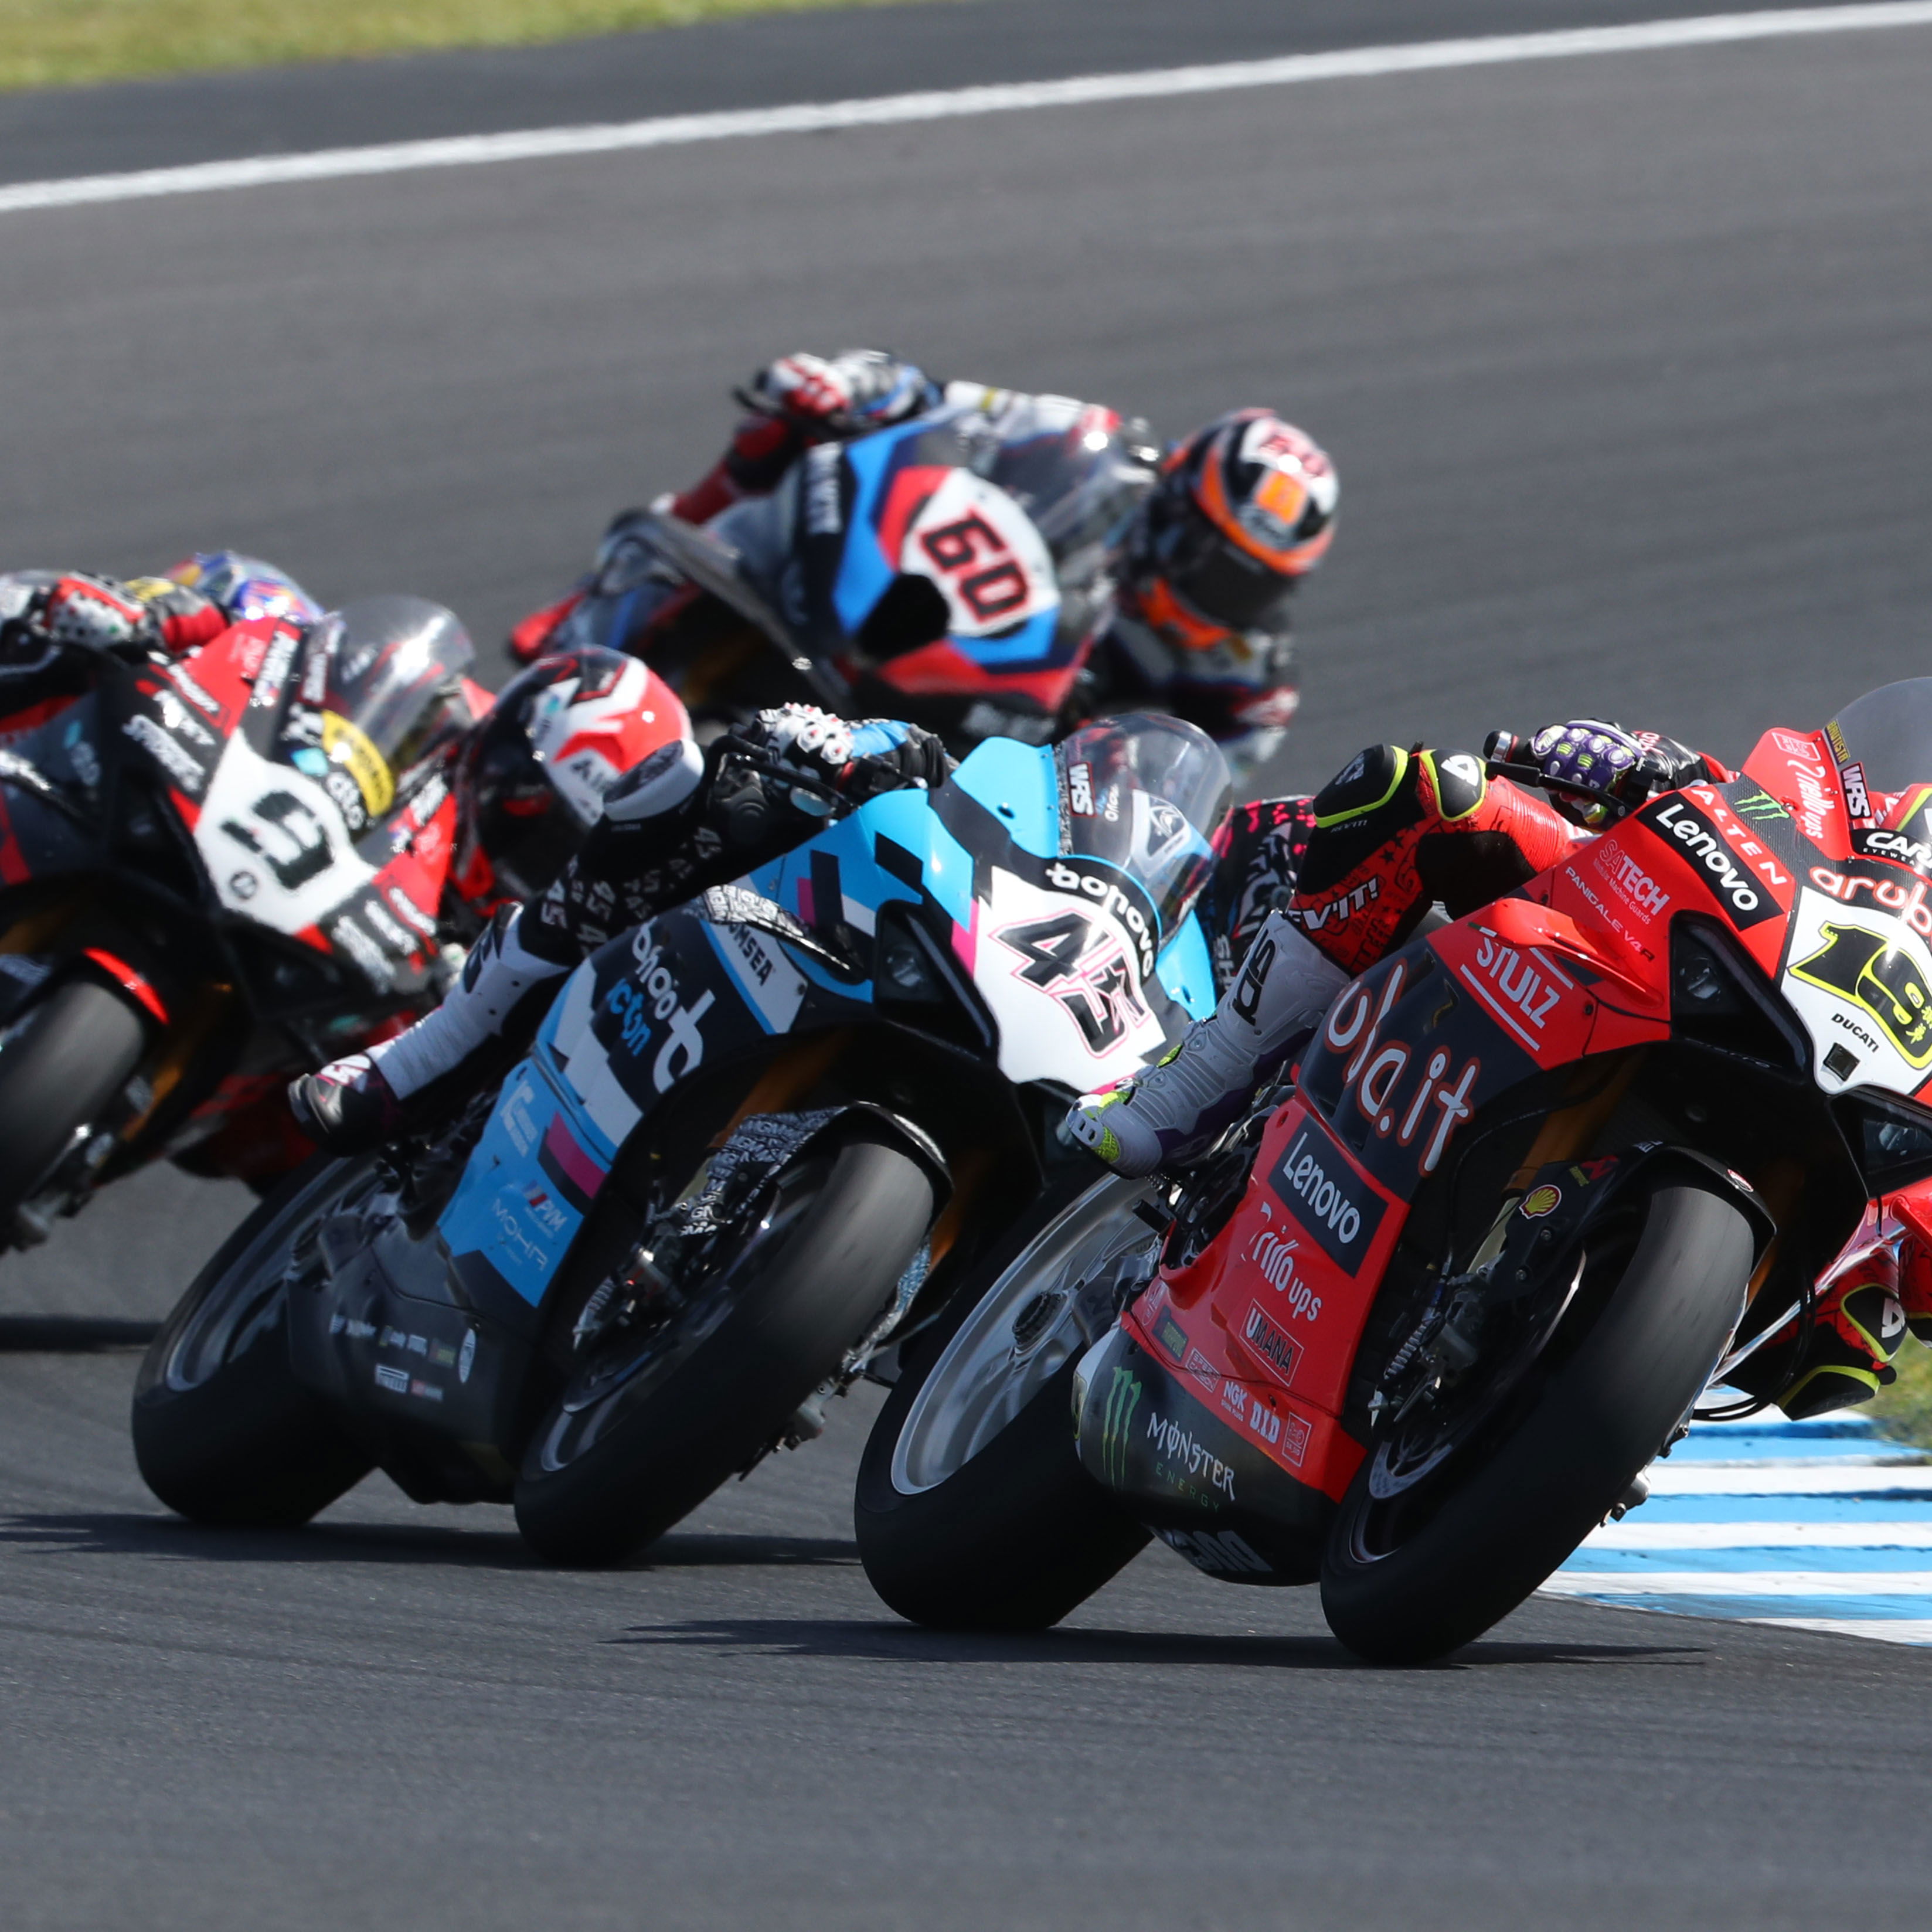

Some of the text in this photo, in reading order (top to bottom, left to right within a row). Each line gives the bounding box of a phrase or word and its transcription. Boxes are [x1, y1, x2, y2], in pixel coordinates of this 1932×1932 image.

[921, 510, 1030, 623] 60
[1069, 763, 1093, 815] WRS
[1843, 766, 1870, 817] WRS
[1655, 803, 1758, 911] Lenovo
[1692, 788, 1787, 885] ALTEN
[1863, 848, 1915, 866] EYEWEA
[1287, 879, 1378, 931] EV'IT!
[1566, 867, 1655, 961] PANIGALE V4R
[1600, 839, 1669, 916] SATECH
[1609, 878, 1630, 904] Machine
[1629, 900, 1651, 924] Guards
[1046, 862, 1154, 977] bonovo
[989, 909, 1150, 1058] 45
[1477, 938, 1560, 1028] STULZ
[1788, 921, 1932, 1069] 19
[1832, 1013, 1879, 1053] DUCATI
[1282, 1132, 1360, 1244] Lenovo
[1288, 1277, 1322, 1321] ups
[1246, 1308, 1293, 1375] UMANA
[1223, 1381, 1248, 1411] NGK
[1147, 1412, 1235, 1501] MONSTER
[1155, 1462, 1219, 1512] ENERGY
